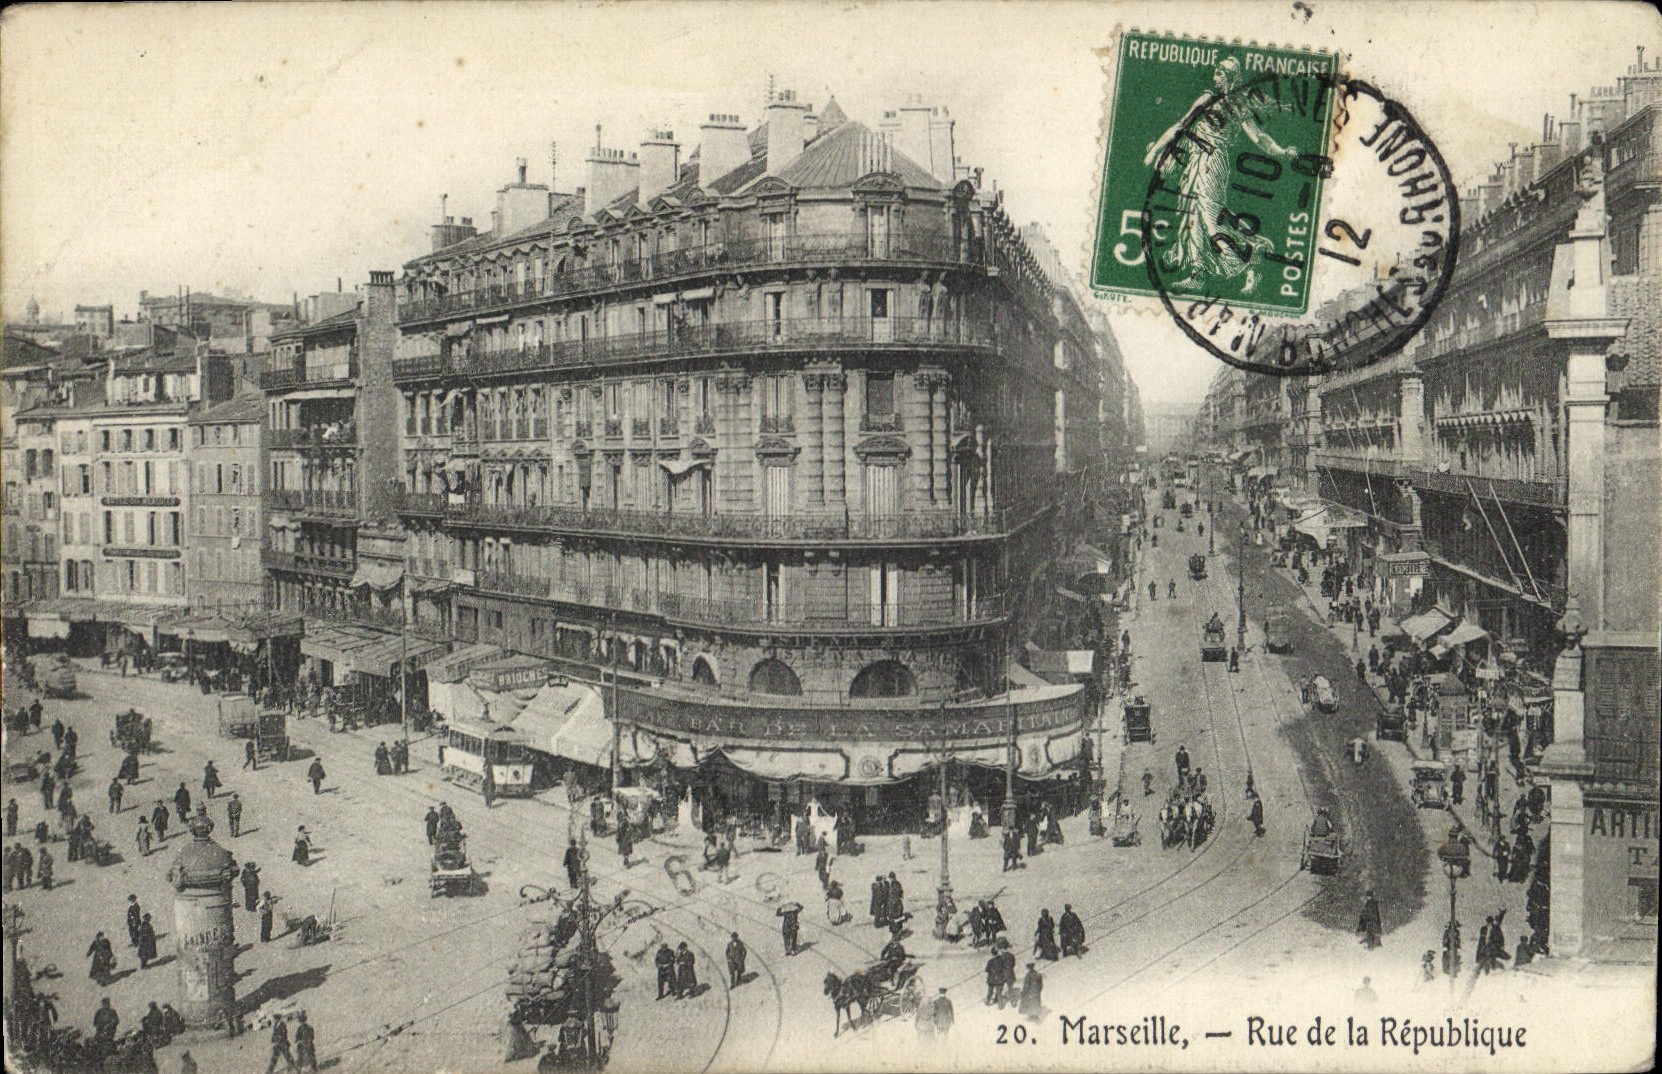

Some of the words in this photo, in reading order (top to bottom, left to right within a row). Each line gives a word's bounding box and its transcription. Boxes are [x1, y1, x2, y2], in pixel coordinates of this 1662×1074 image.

[690, 715, 747, 736] BAR
[764, 721, 807, 737] DE
[830, 721, 876, 737] LA
[1590, 807, 1658, 839] ARTI
[1628, 846, 1658, 866] T
